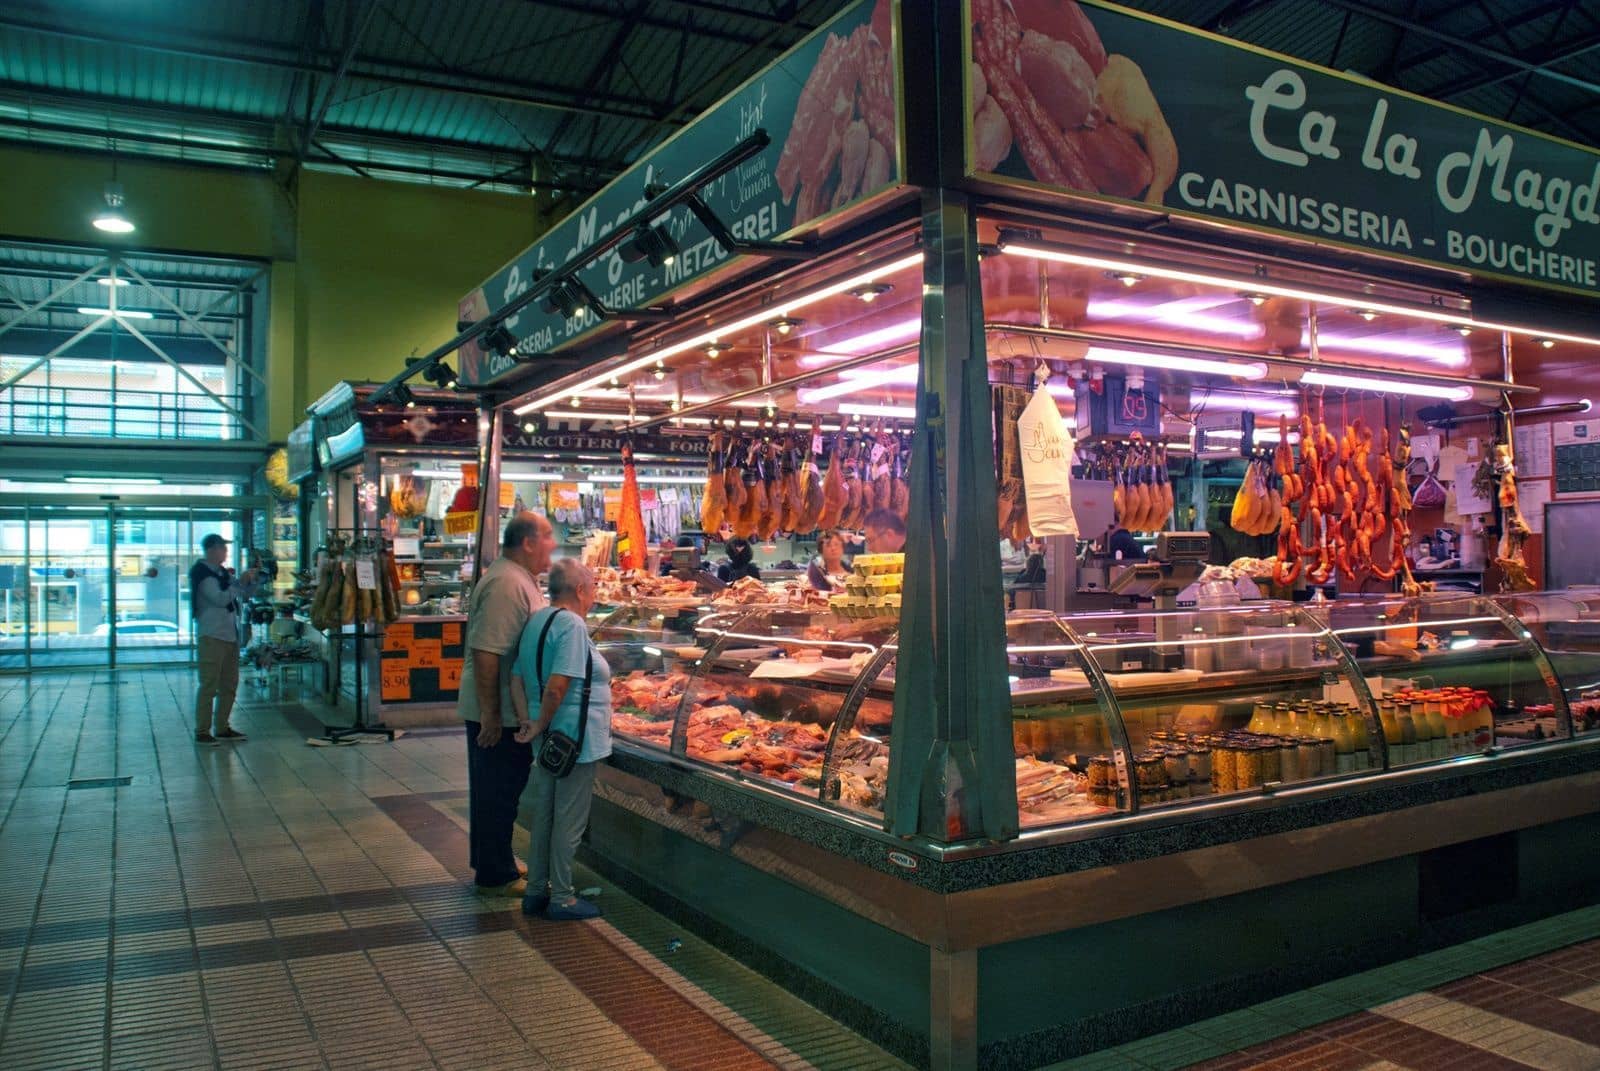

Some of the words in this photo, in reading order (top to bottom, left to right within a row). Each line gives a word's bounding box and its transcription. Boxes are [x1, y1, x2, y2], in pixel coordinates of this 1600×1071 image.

[1245, 69, 1340, 167] Ca
[1361, 98, 1421, 179] la
[1179, 172, 1413, 250] CARNISSERIA
[1446, 230, 1597, 287] BOUCHERIE
[490, 326, 553, 375] CARSERIA
